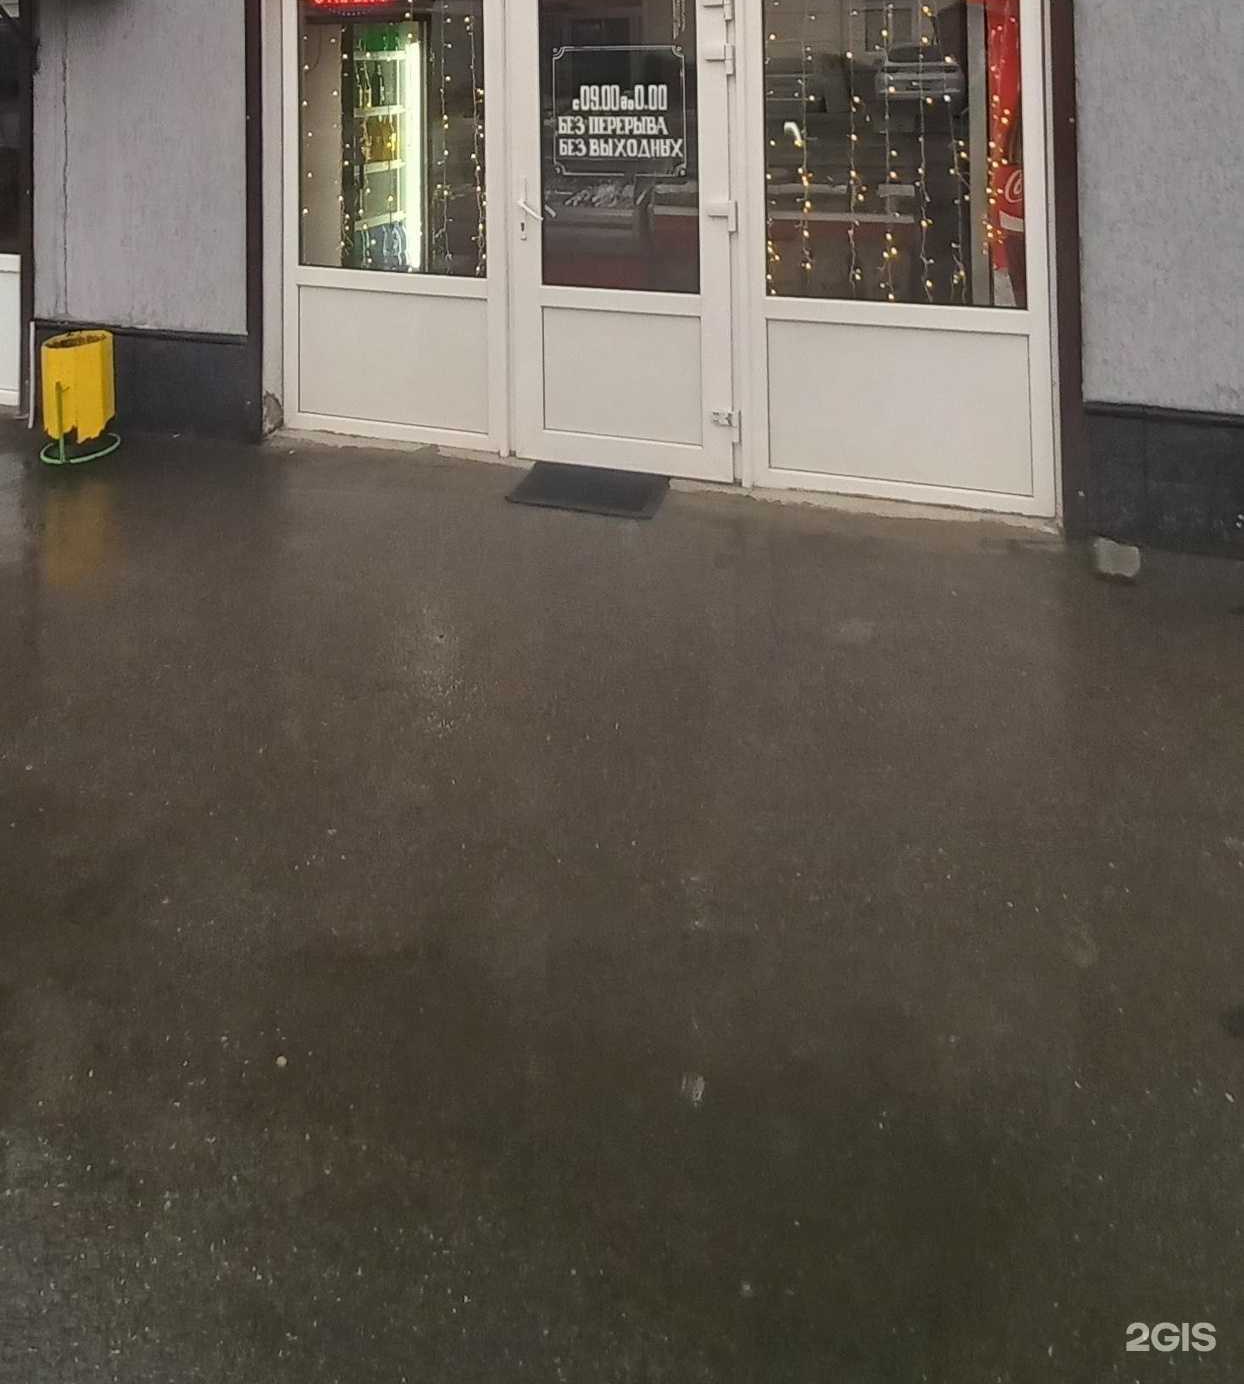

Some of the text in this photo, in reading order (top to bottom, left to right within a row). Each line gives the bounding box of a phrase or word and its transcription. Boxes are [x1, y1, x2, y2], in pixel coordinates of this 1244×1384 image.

[580, 85, 620, 111] 09.00
[558, 116, 669, 135] БЕЗ ПЕРЕРЫВА
[559, 138, 684, 158] БЕЗ ВЫХОДНЫХ
